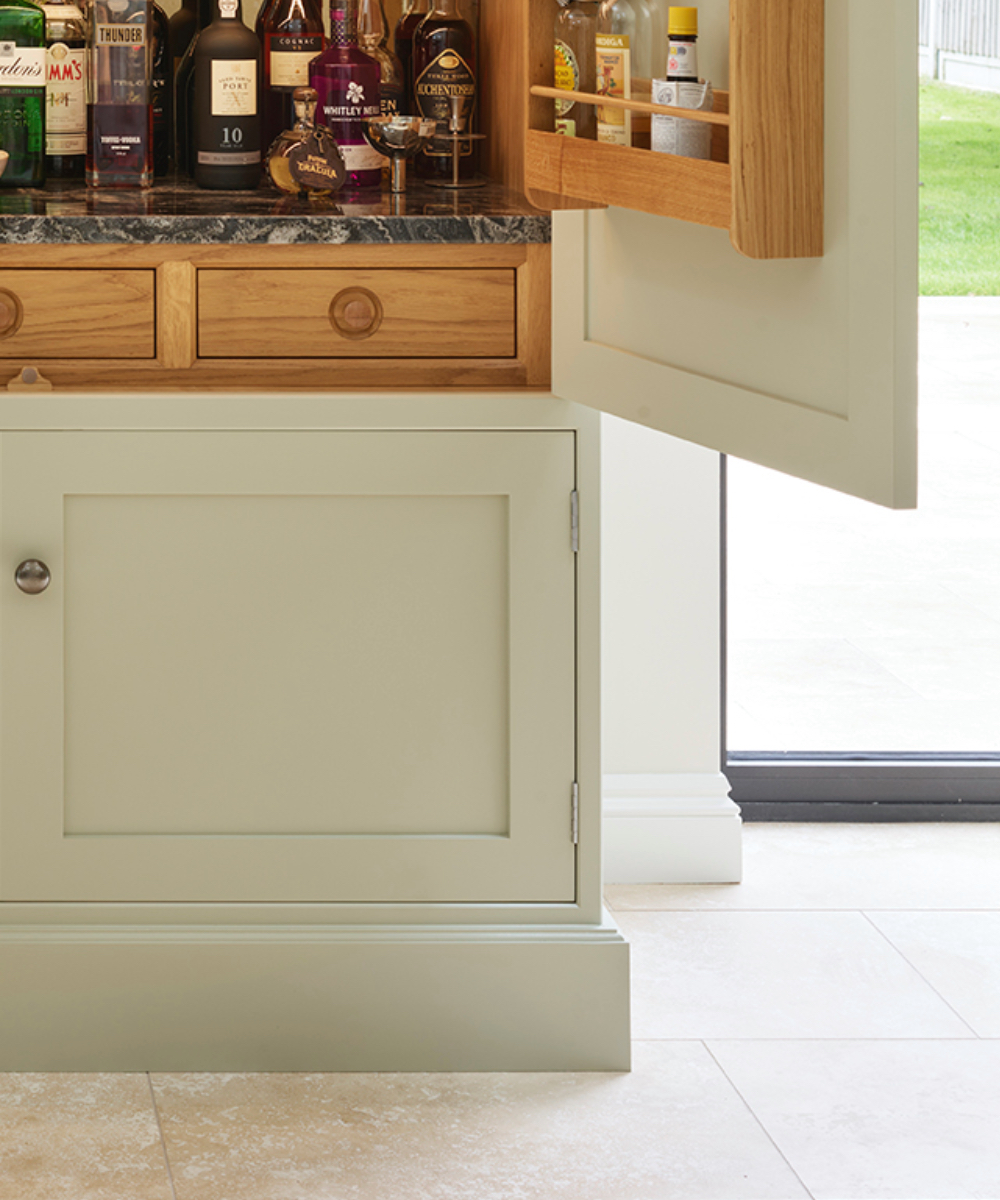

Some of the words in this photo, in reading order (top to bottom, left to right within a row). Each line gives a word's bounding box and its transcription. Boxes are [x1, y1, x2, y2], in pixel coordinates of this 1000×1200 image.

[100, 27, 143, 43] THUNDER
[45, 59, 82, 81] IMM'S
[323, 106, 361, 116] WHITLEY
[222, 127, 243, 145] 10
